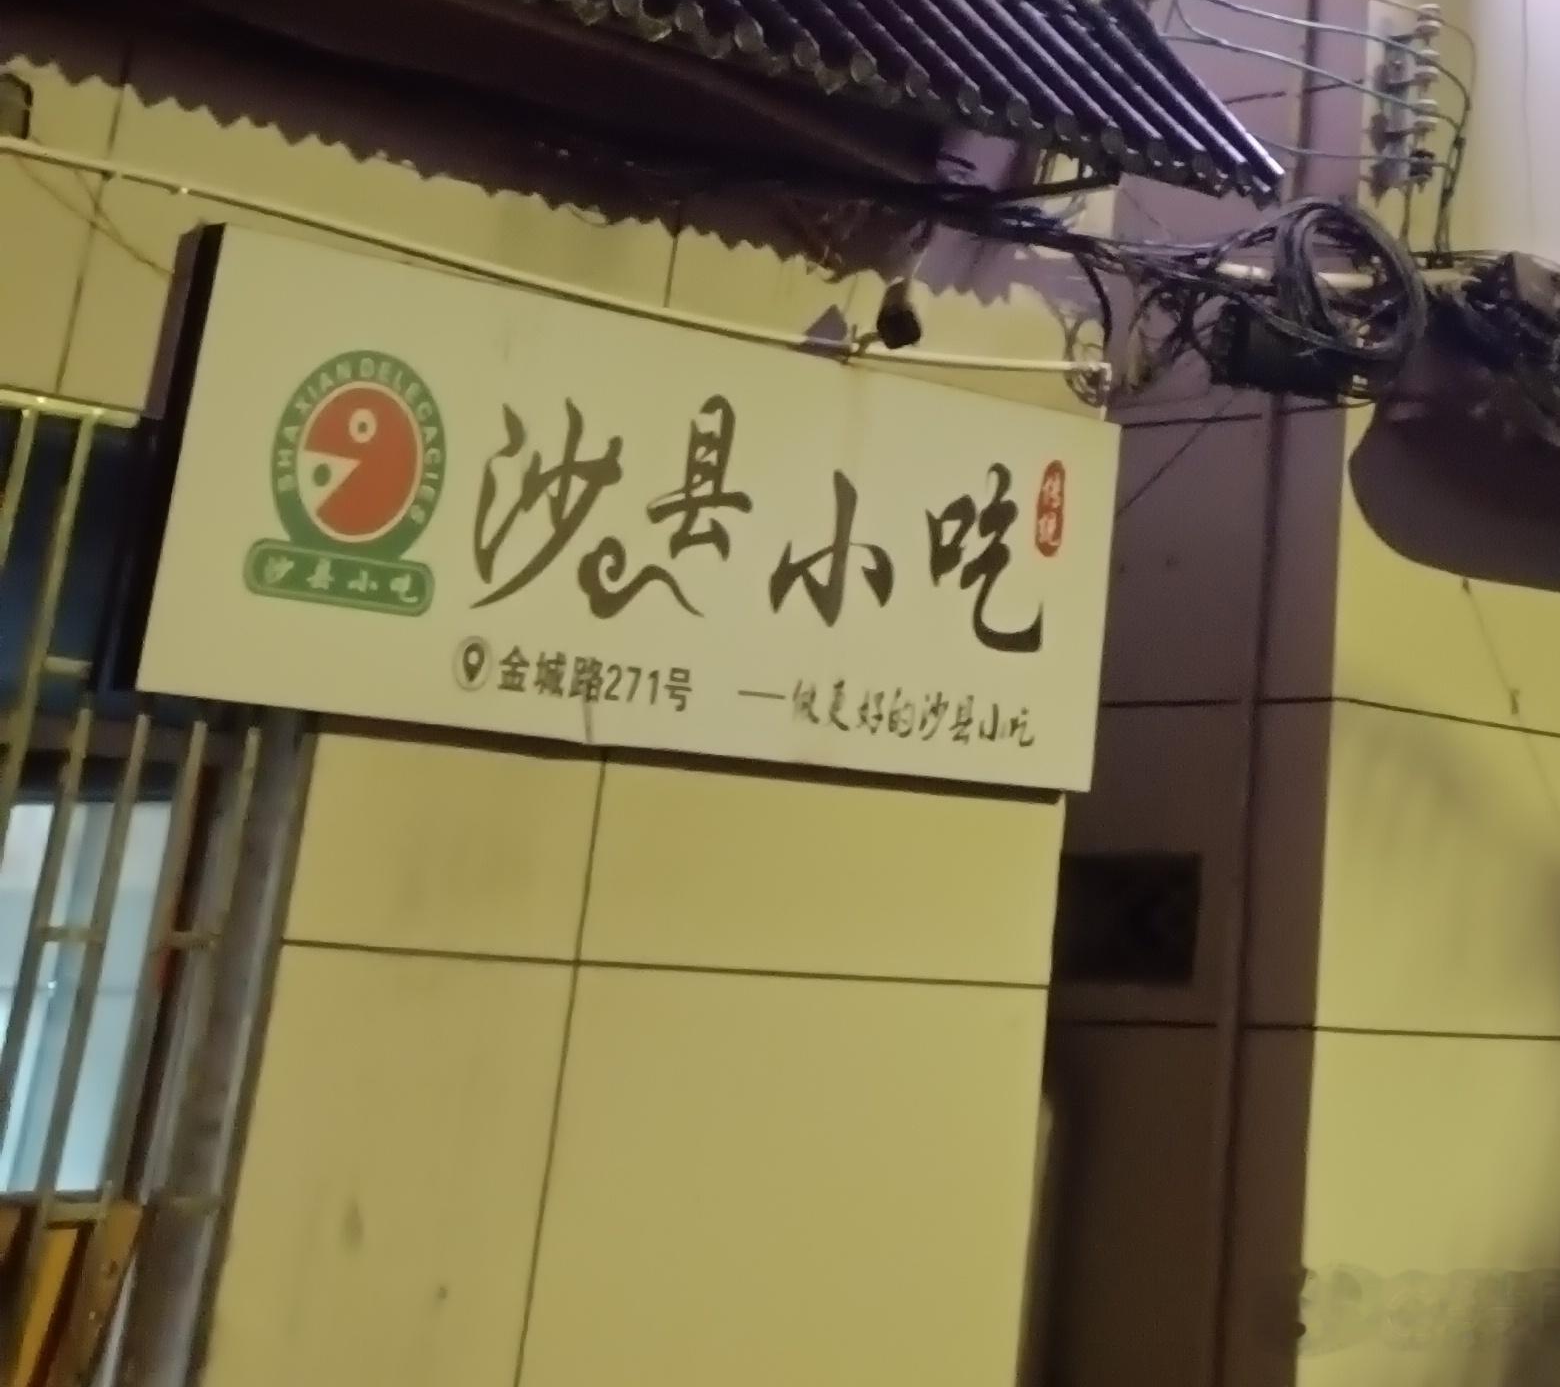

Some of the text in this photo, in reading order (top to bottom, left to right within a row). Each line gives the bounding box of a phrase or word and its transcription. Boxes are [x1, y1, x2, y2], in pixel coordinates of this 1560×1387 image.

[469, 392, 1044, 653] 沙县小吃
[263, 554, 420, 604] 沙县小吃
[496, 644, 694, 713] 金城路271号
